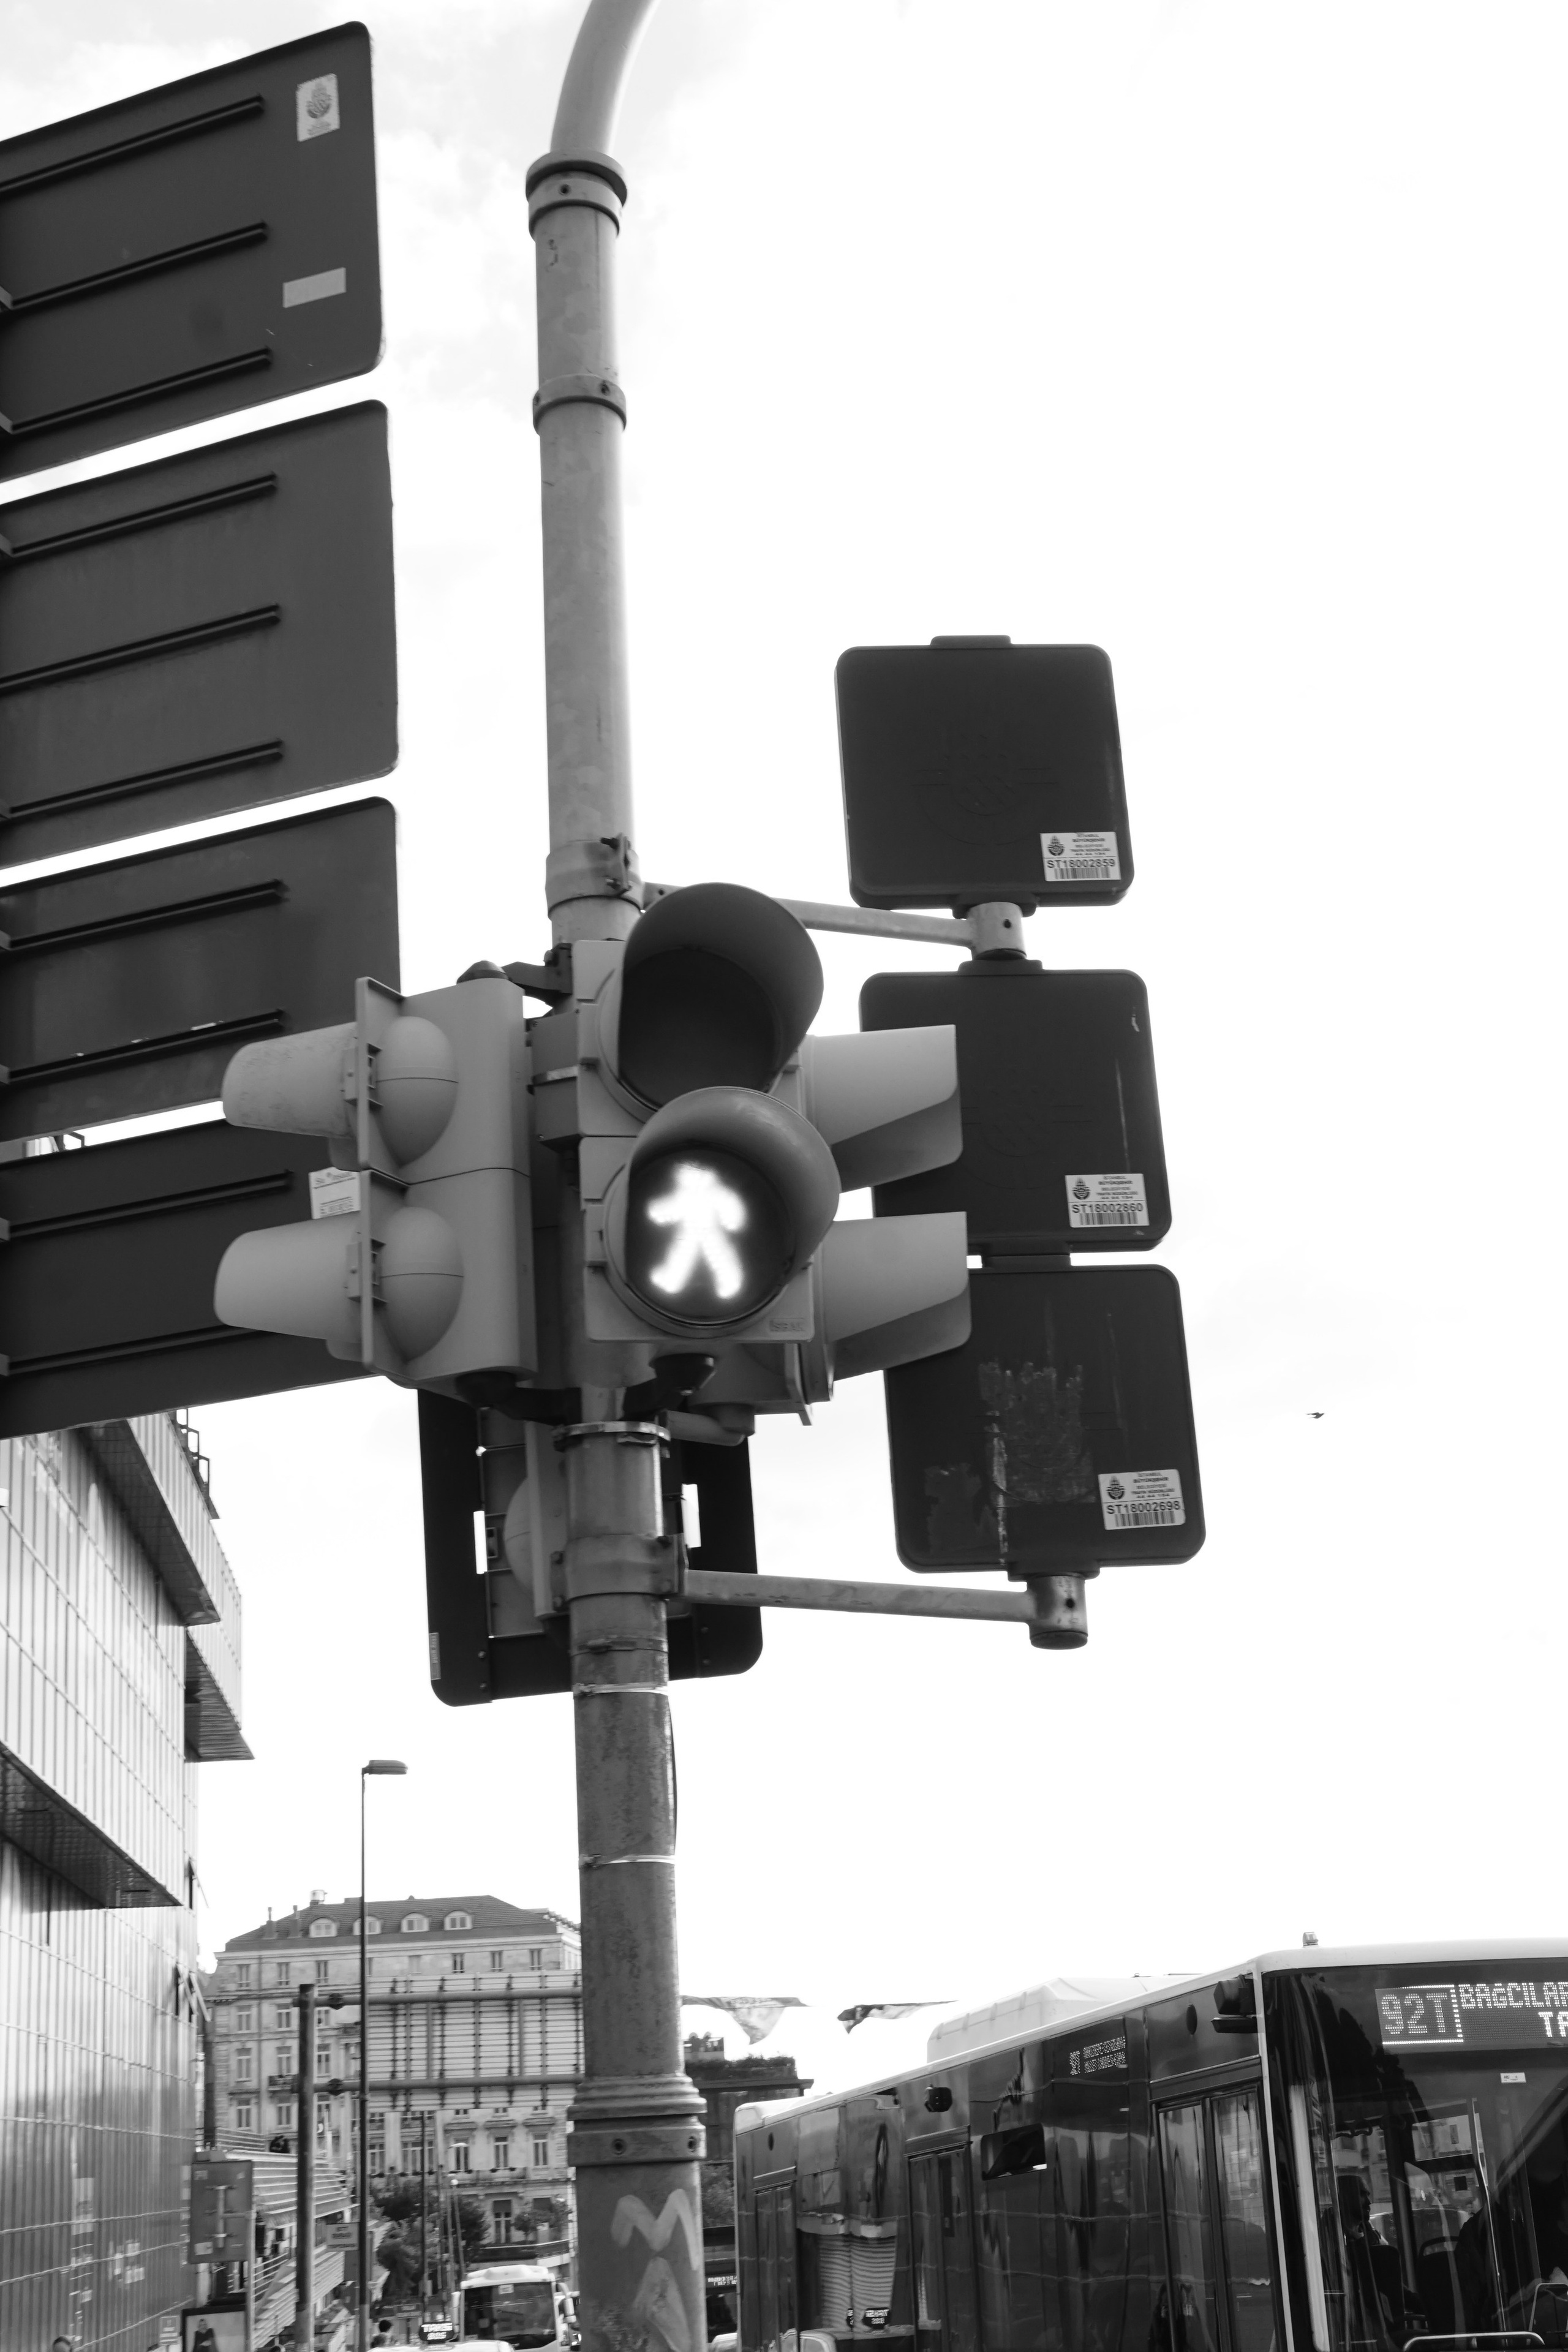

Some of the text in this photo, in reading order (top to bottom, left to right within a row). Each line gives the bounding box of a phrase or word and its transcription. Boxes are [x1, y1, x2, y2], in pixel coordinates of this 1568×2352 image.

[1072, 1202, 1144, 1213] ST18002860
[1106, 1501, 1181, 1515] ST18002698
[1381, 1992, 1448, 2035] 92T
